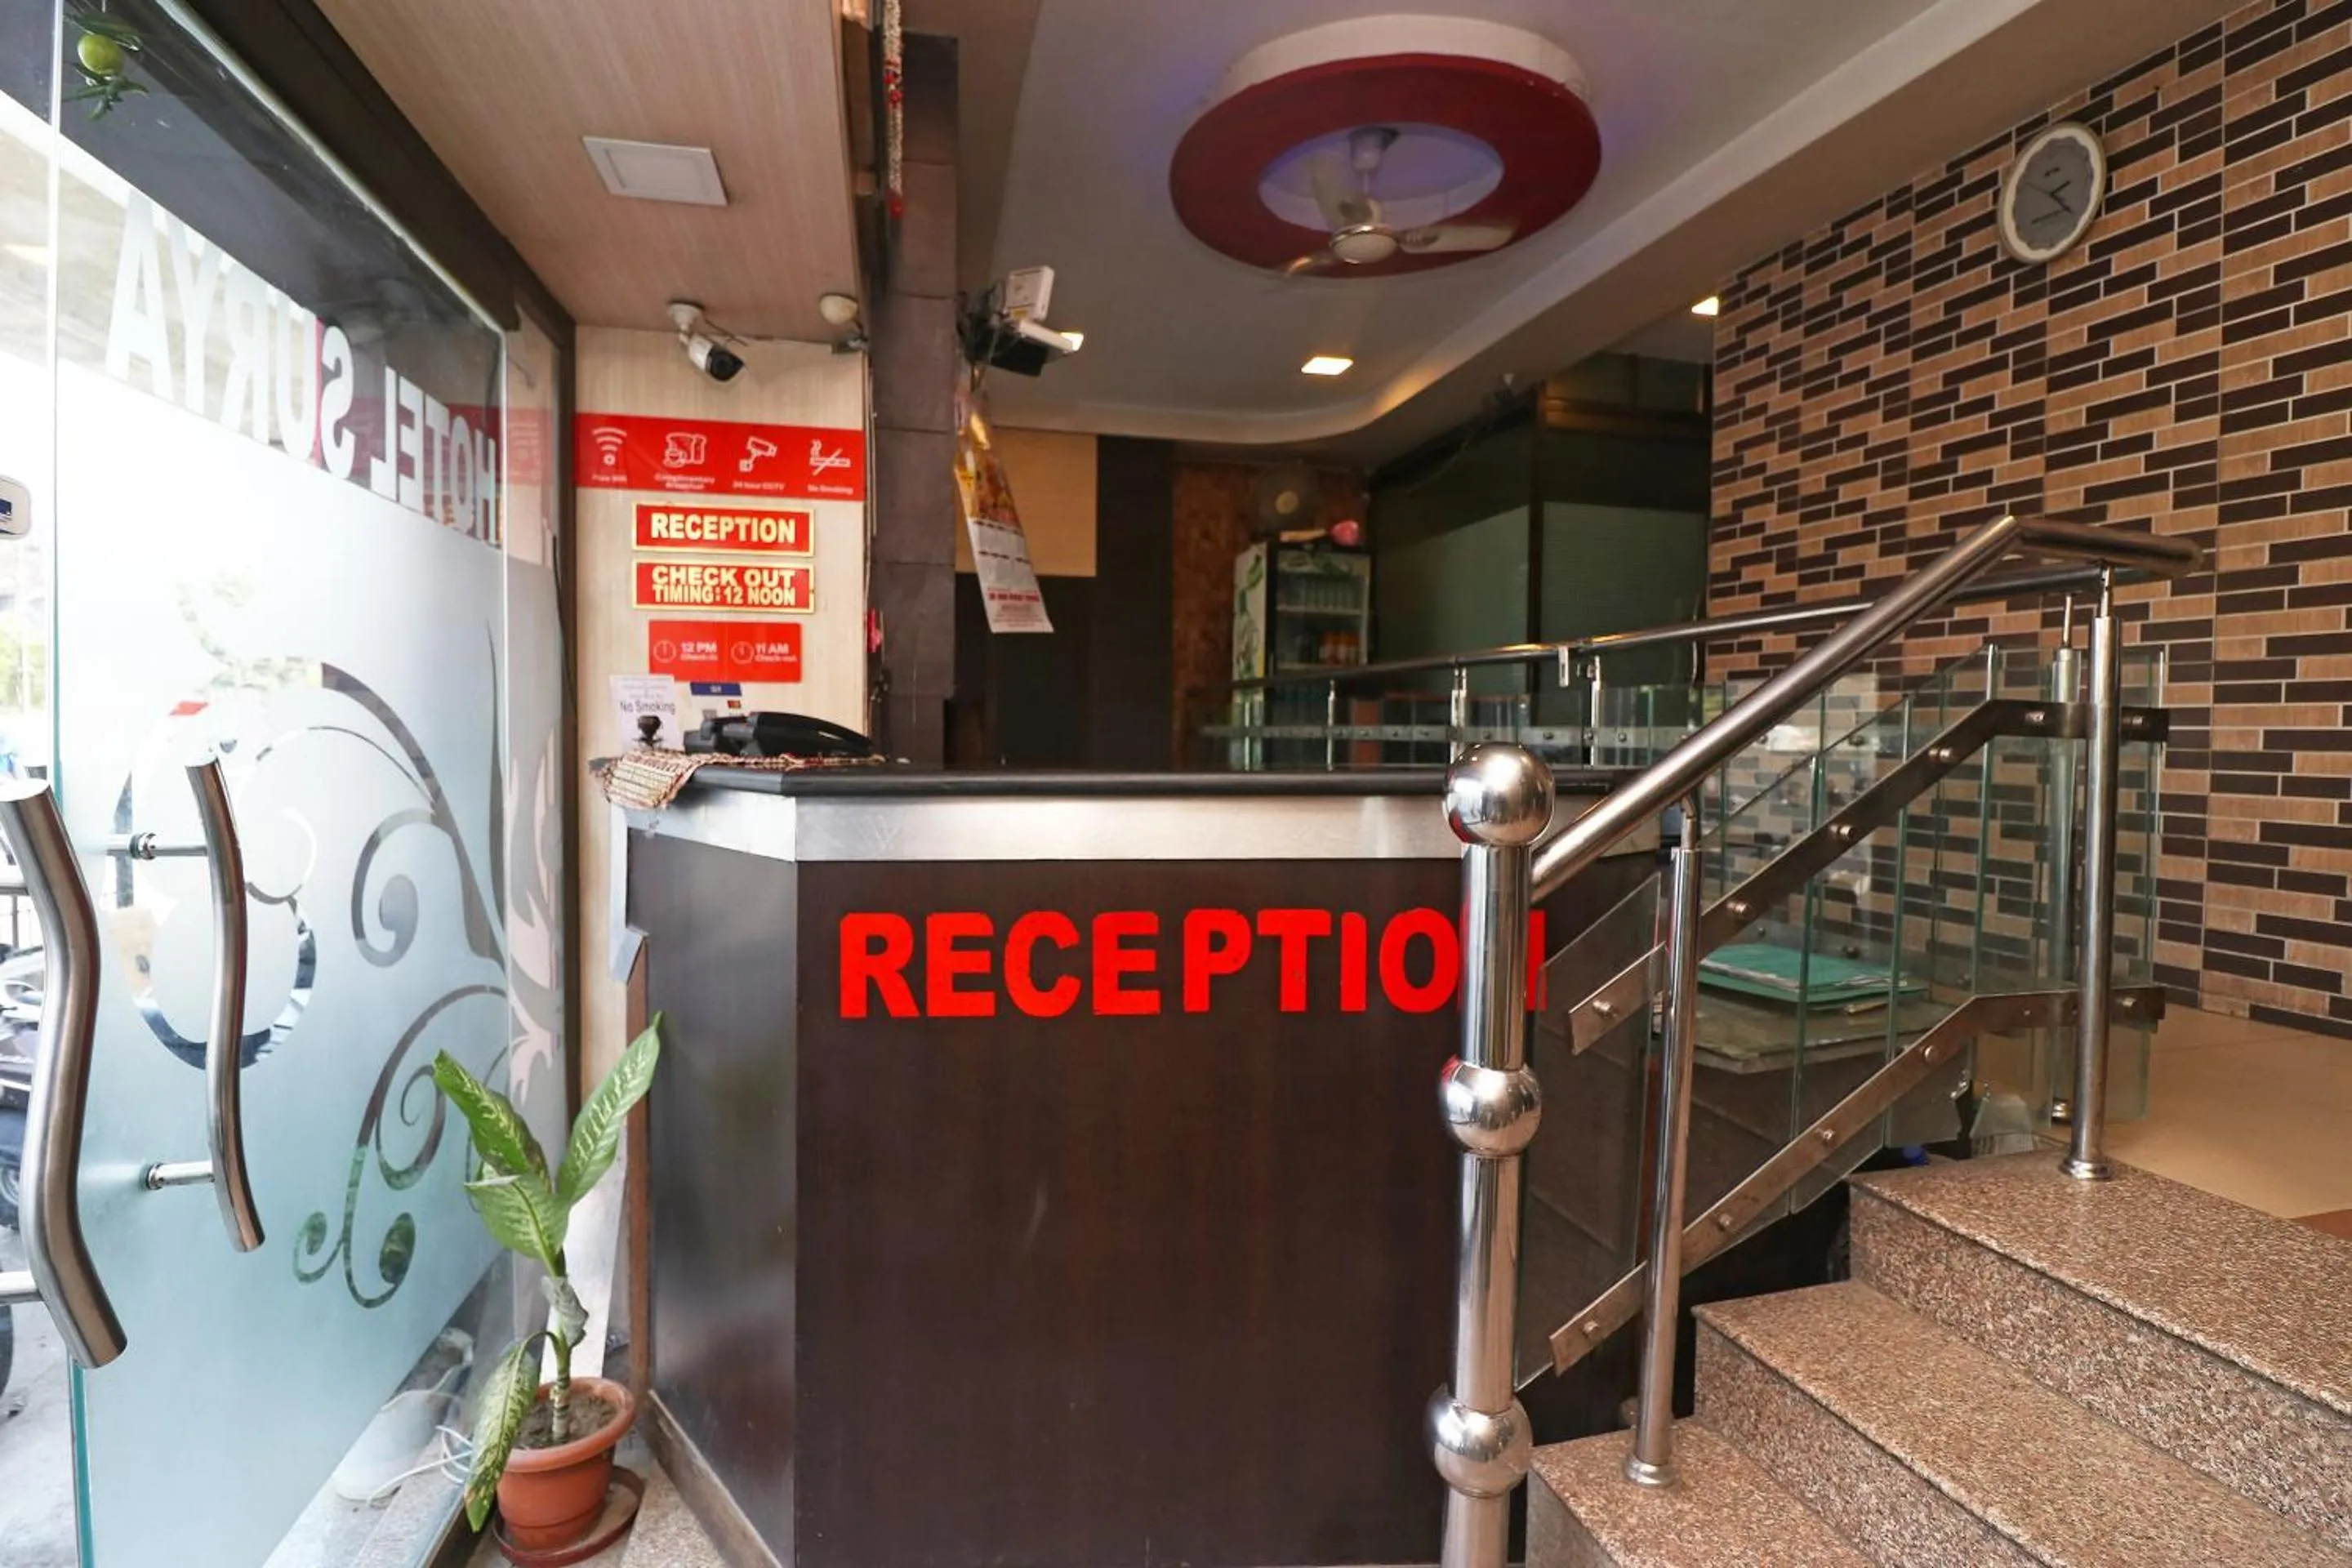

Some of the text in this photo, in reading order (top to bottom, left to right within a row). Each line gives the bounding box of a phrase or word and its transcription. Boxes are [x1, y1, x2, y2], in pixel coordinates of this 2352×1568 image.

[651, 513, 795, 543] RECEPTION
[652, 566, 795, 588] CHECK OUT
[724, 586, 743, 604] 12
[747, 587, 795, 606] NOON
[681, 640, 718, 654] 12 PM
[755, 642, 790, 655] 11 AM
[620, 700, 676, 716] No Smoking
